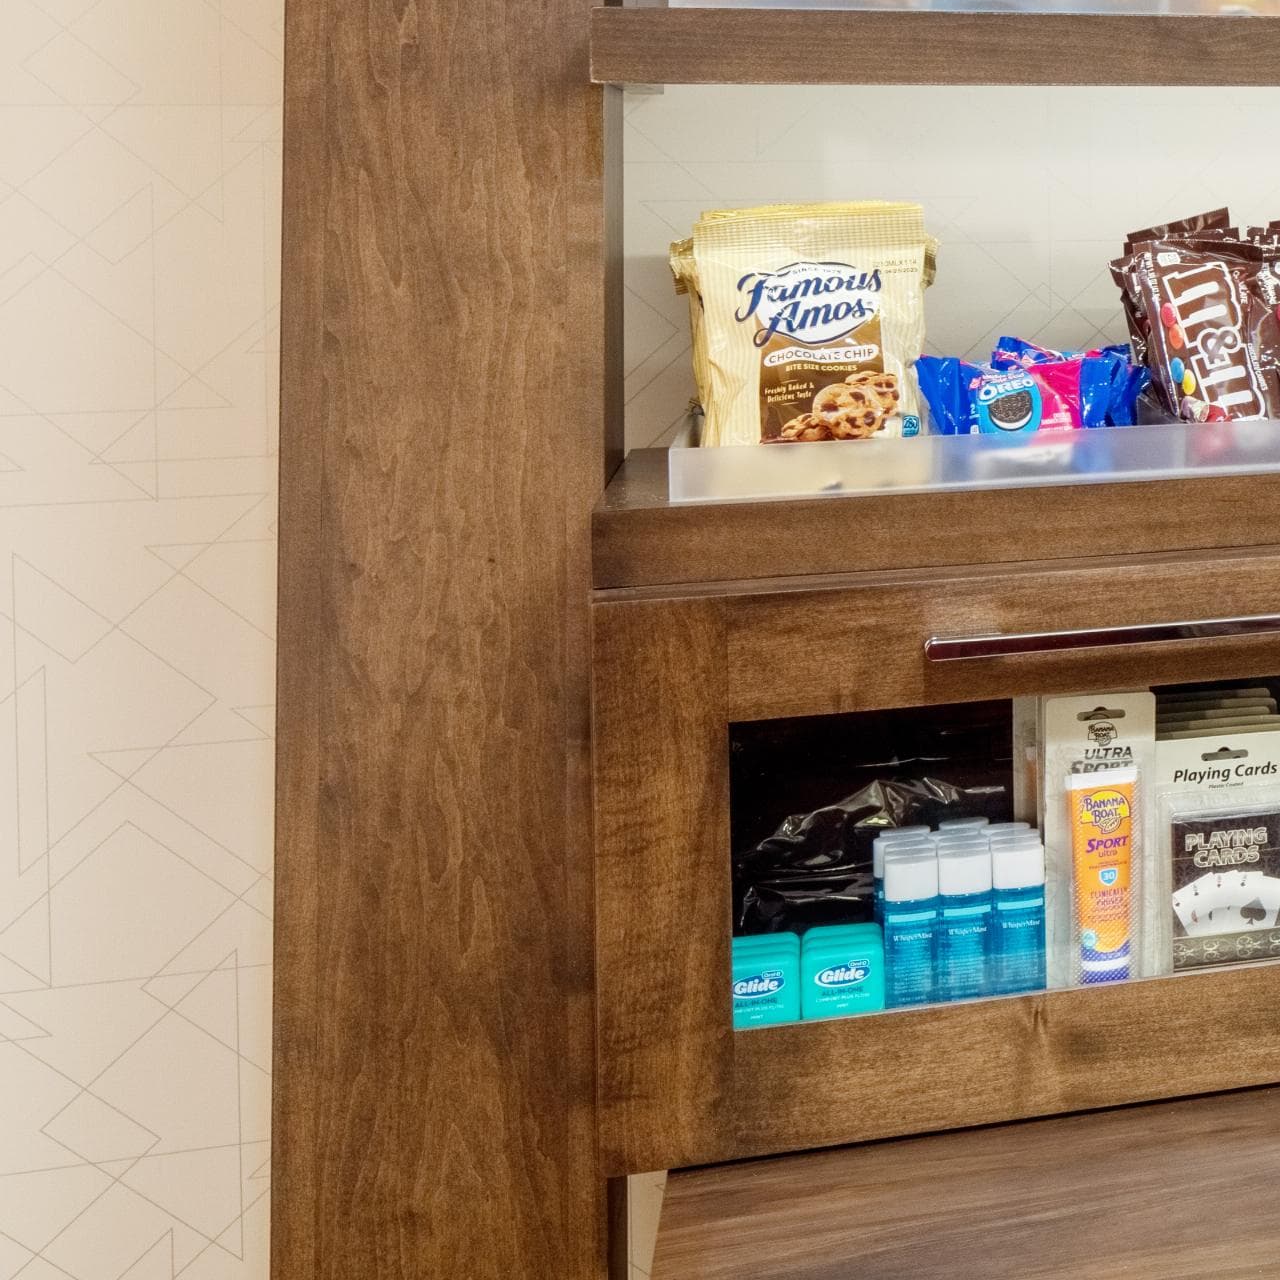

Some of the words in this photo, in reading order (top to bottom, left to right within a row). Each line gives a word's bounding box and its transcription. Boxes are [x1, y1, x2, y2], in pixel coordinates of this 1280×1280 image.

[734, 269, 882, 323] Famous
[753, 297, 876, 348] Amos
[768, 350, 841, 364] CHOCOLATE
[844, 348, 875, 360] CHIP
[785, 364, 802, 372] BITE
[821, 364, 858, 372] COOKIES
[978, 378, 1034, 401] OREO
[1084, 745, 1133, 760] ULTRA
[1172, 766, 1231, 784] Playing
[1234, 761, 1278, 778] Cards
[1083, 796, 1126, 812] BANANA
[1091, 807, 1120, 821] BOAT
[1085, 835, 1129, 854] SPORT
[1184, 826, 1268, 852] PLAYING
[1193, 845, 1261, 868] CARDS
[1102, 871, 1115, 881] 30
[821, 967, 866, 984] Glide
[734, 978, 780, 995] Glide
[821, 985, 864, 997] ALL-IN-ONE
[734, 998, 778, 1008] ALL-IN-ONE
